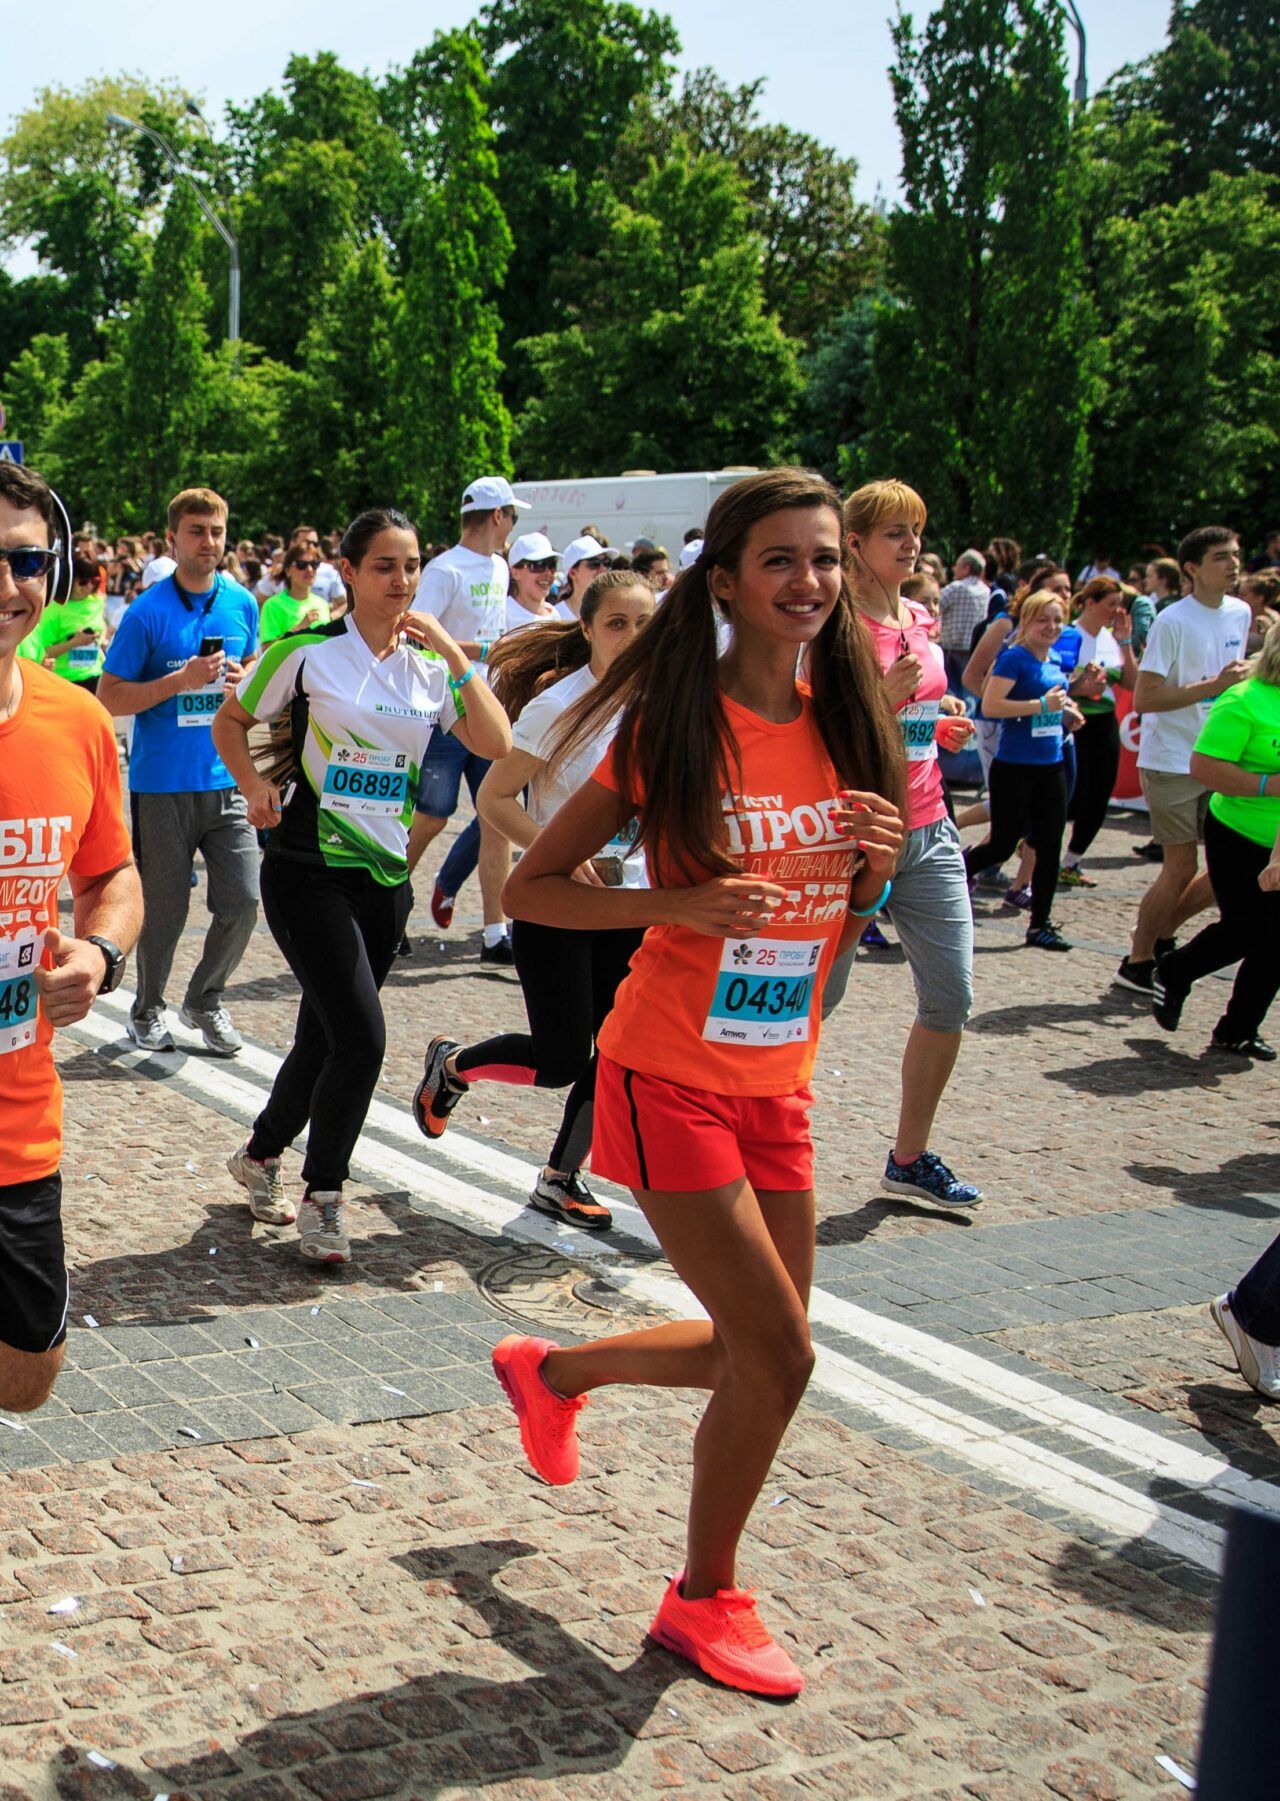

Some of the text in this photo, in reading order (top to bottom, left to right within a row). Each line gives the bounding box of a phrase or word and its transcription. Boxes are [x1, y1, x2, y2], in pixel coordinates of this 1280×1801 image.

[183, 694, 224, 712] 0385
[352, 752, 367, 764] 25
[333, 769, 403, 798] 06892
[723, 798, 848, 855] ПРОБ
[755, 949, 777, 966] 25
[724, 977, 809, 1015] 04340
[719, 1027, 748, 1040] Amway
